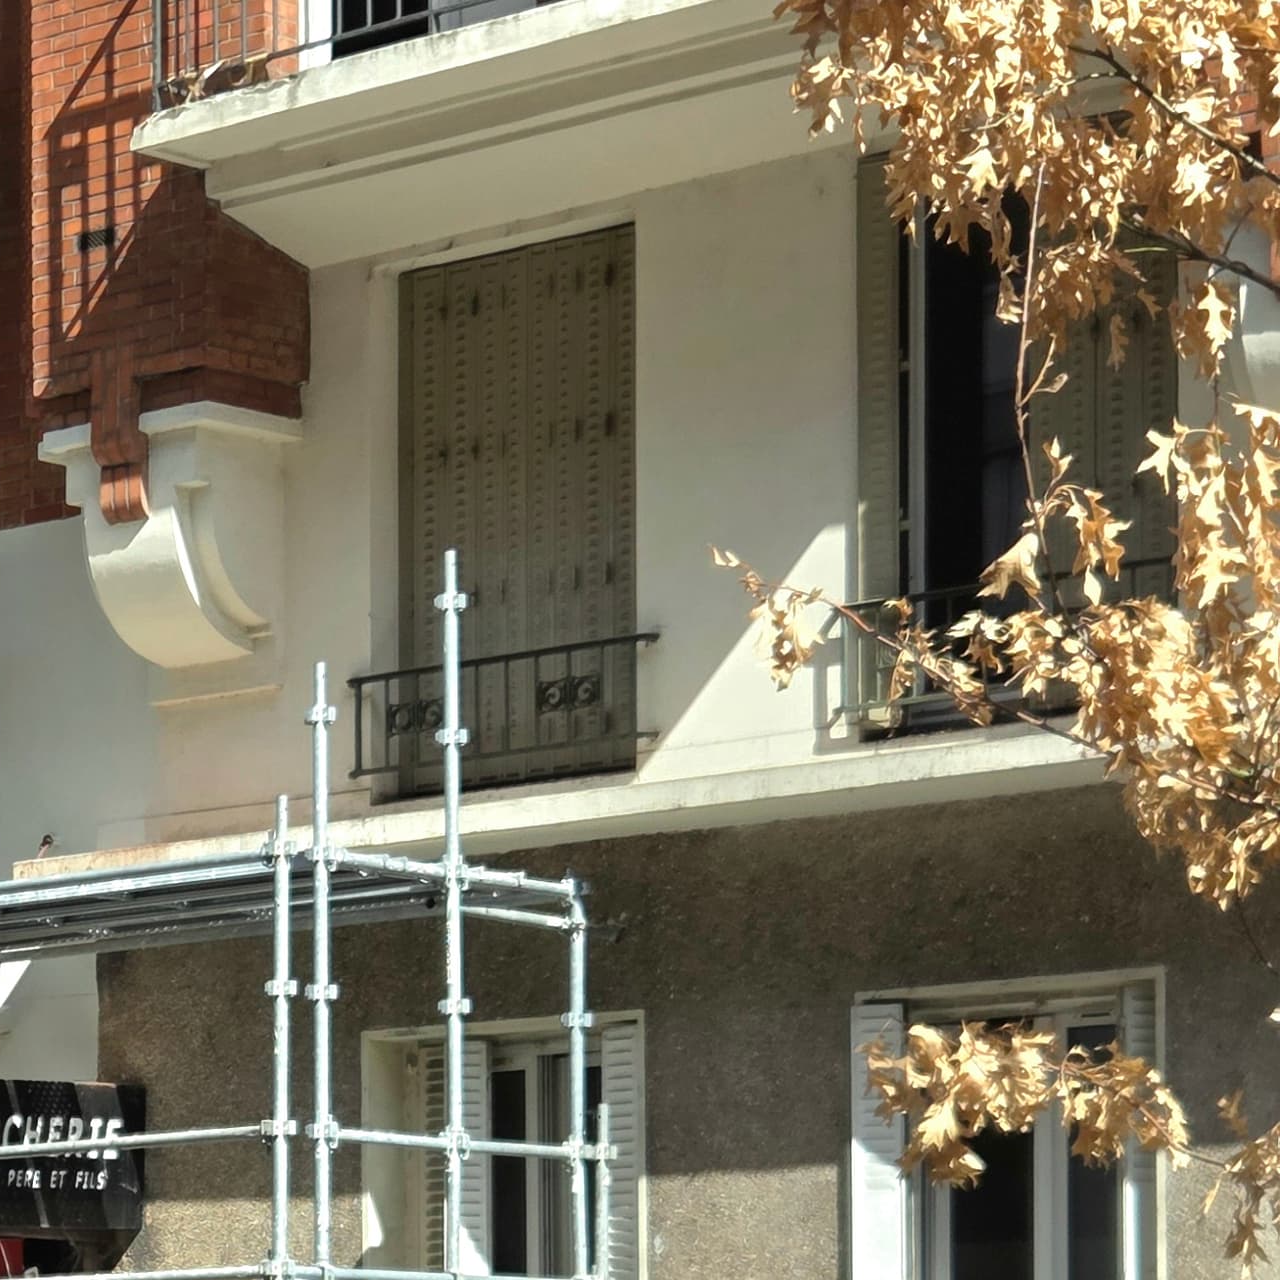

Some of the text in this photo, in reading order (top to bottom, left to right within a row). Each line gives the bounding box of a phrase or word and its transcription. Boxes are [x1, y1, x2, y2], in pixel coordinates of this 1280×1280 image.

[7, 1169, 41, 1189] PERE
[50, 1170, 67, 1189] ET
[75, 1171, 106, 1190] FILS
